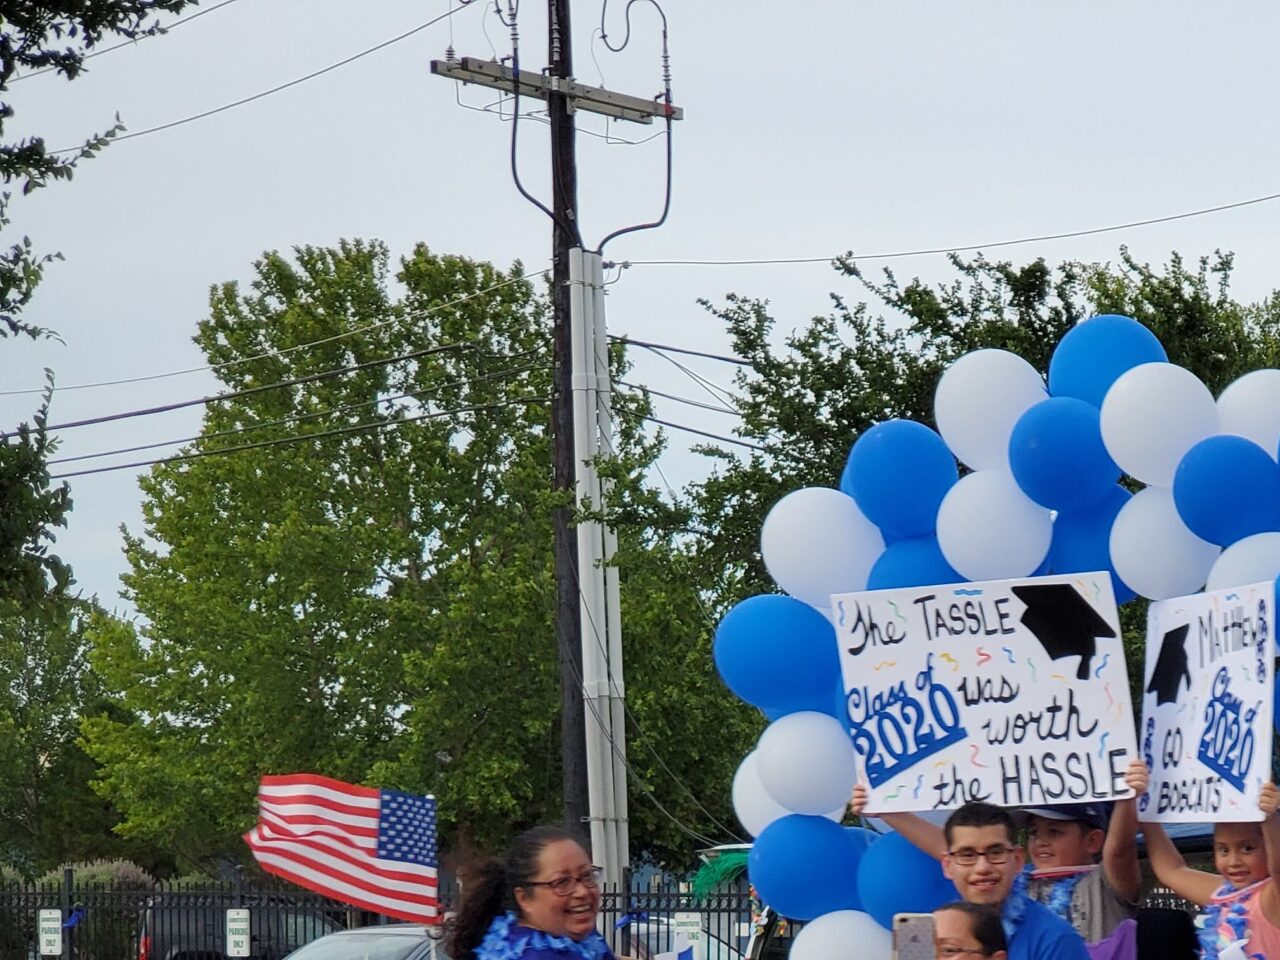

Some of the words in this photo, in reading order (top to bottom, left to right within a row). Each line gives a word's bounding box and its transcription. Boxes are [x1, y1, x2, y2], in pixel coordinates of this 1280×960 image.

[848, 599, 906, 656] The
[914, 594, 1016, 641] TASSLE
[847, 680, 909, 728] Class
[915, 652, 935, 692] of
[956, 673, 1020, 707] was
[981, 688, 1098, 745] worth
[852, 683, 968, 790] 2020
[1162, 727, 1183, 770] GO
[1198, 700, 1254, 793] 2020
[933, 763, 992, 809] the
[1000, 748, 1131, 805] HASSLE
[1157, 776, 1222, 814] BOBCATS
